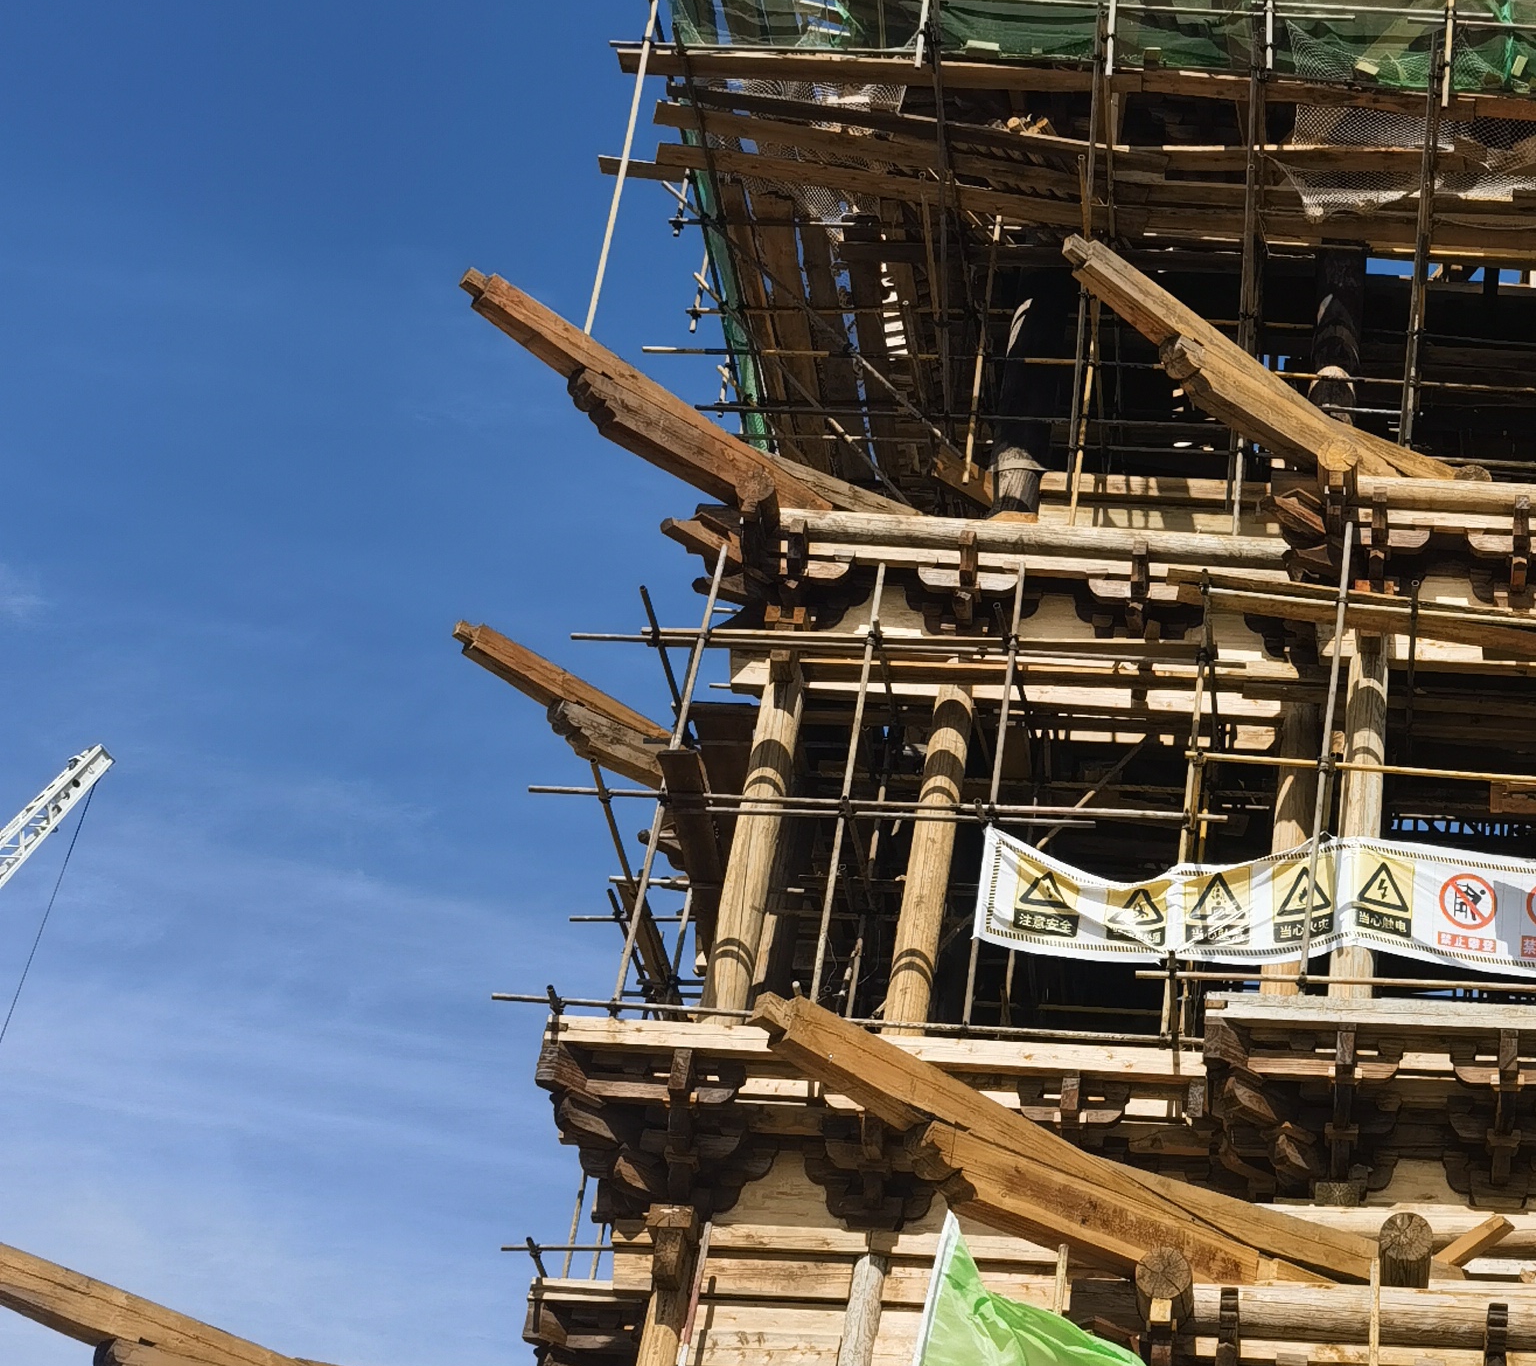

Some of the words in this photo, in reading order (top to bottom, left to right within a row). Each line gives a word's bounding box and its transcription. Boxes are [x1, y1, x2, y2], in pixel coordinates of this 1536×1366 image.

[1018, 913, 1073, 935] 注意安全
[1358, 911, 1407, 933] 当心触电
[1441, 932, 1495, 952] 禁止攀登
